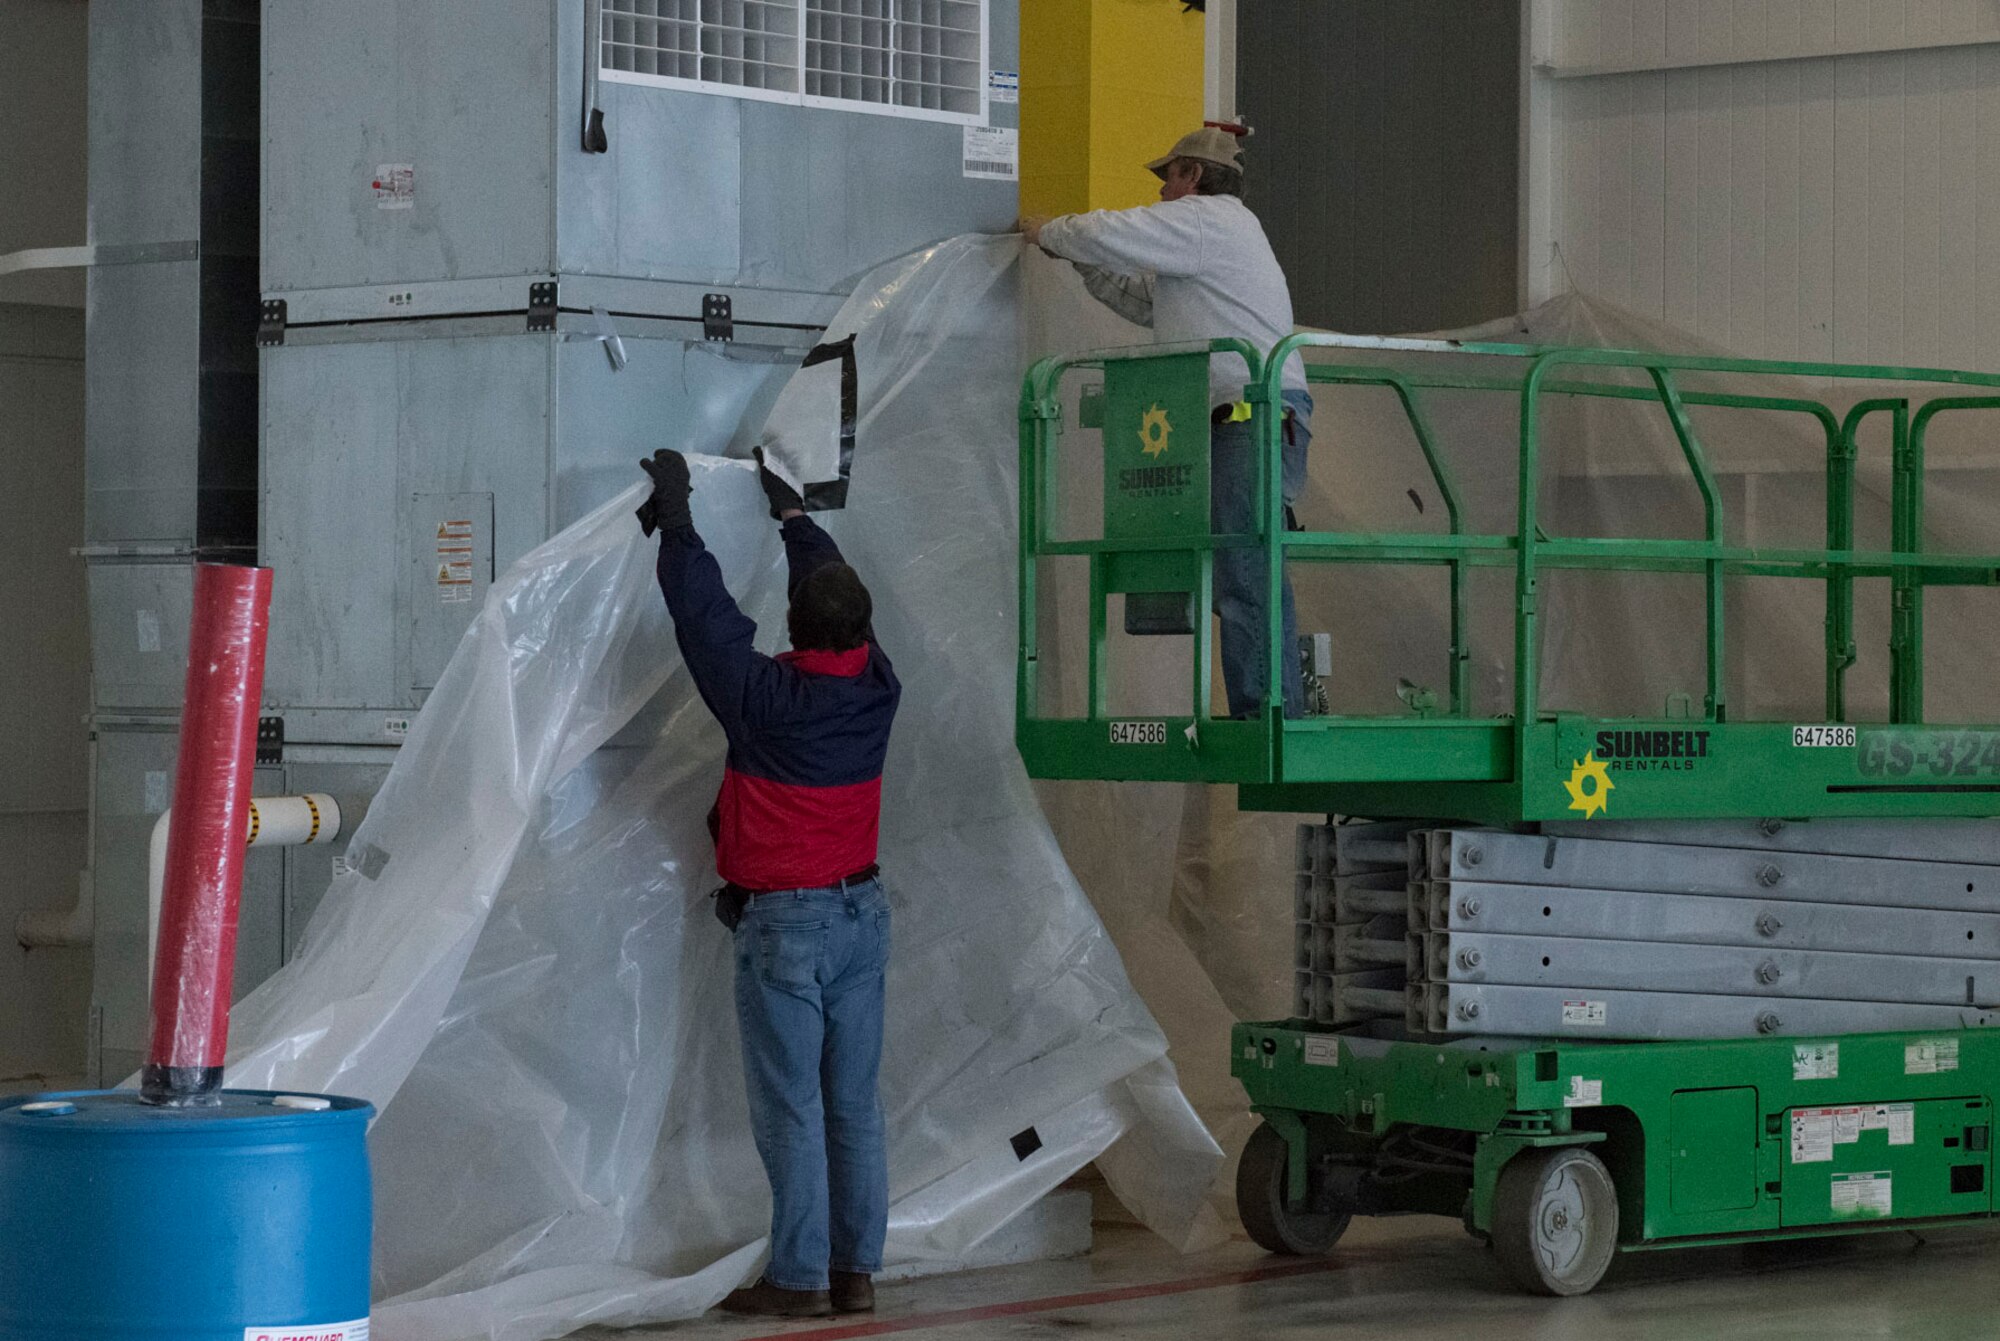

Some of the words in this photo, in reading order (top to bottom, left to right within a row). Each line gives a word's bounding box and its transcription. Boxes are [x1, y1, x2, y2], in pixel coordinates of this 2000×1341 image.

[1119, 465, 1193, 490] SUNBELT
[1111, 723, 1165, 743] 647586
[1794, 727, 1855, 746] 647586
[1596, 731, 1710, 758] SUNBELT
[1612, 760, 1694, 771] RENTALS
